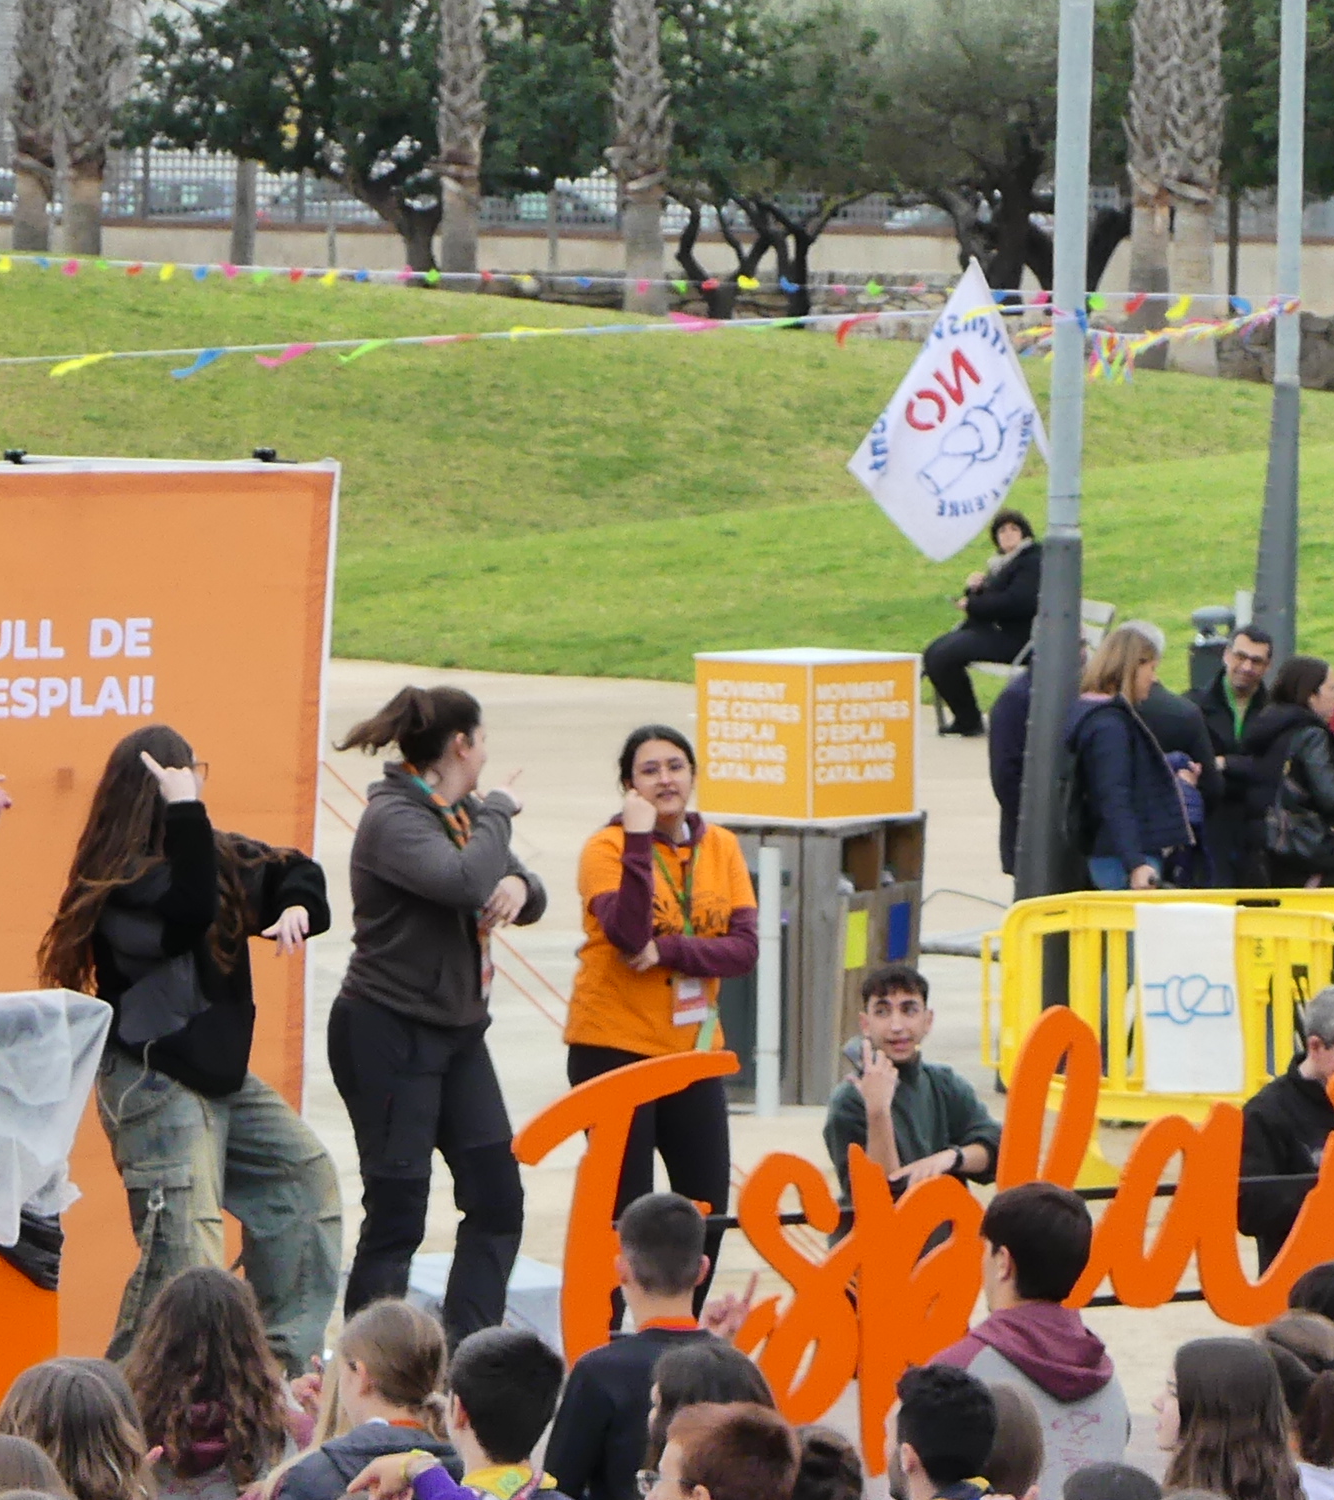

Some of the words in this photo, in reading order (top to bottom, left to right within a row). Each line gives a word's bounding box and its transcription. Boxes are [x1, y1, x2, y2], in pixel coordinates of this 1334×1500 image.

[88, 617, 153, 658] DE
[707, 679, 787, 701] MOVIMENT
[816, 680, 895, 700] MOVIMENT
[707, 700, 729, 719] DE
[731, 701, 802, 724] CENTRES
[816, 703, 837, 722] DE
[839, 700, 910, 721] CENTRES
[707, 740, 788, 763] CRISTIANS
[816, 741, 896, 764] CRISTIANS
[707, 761, 787, 784] CATALANS
[816, 762, 895, 785] CATALANS
